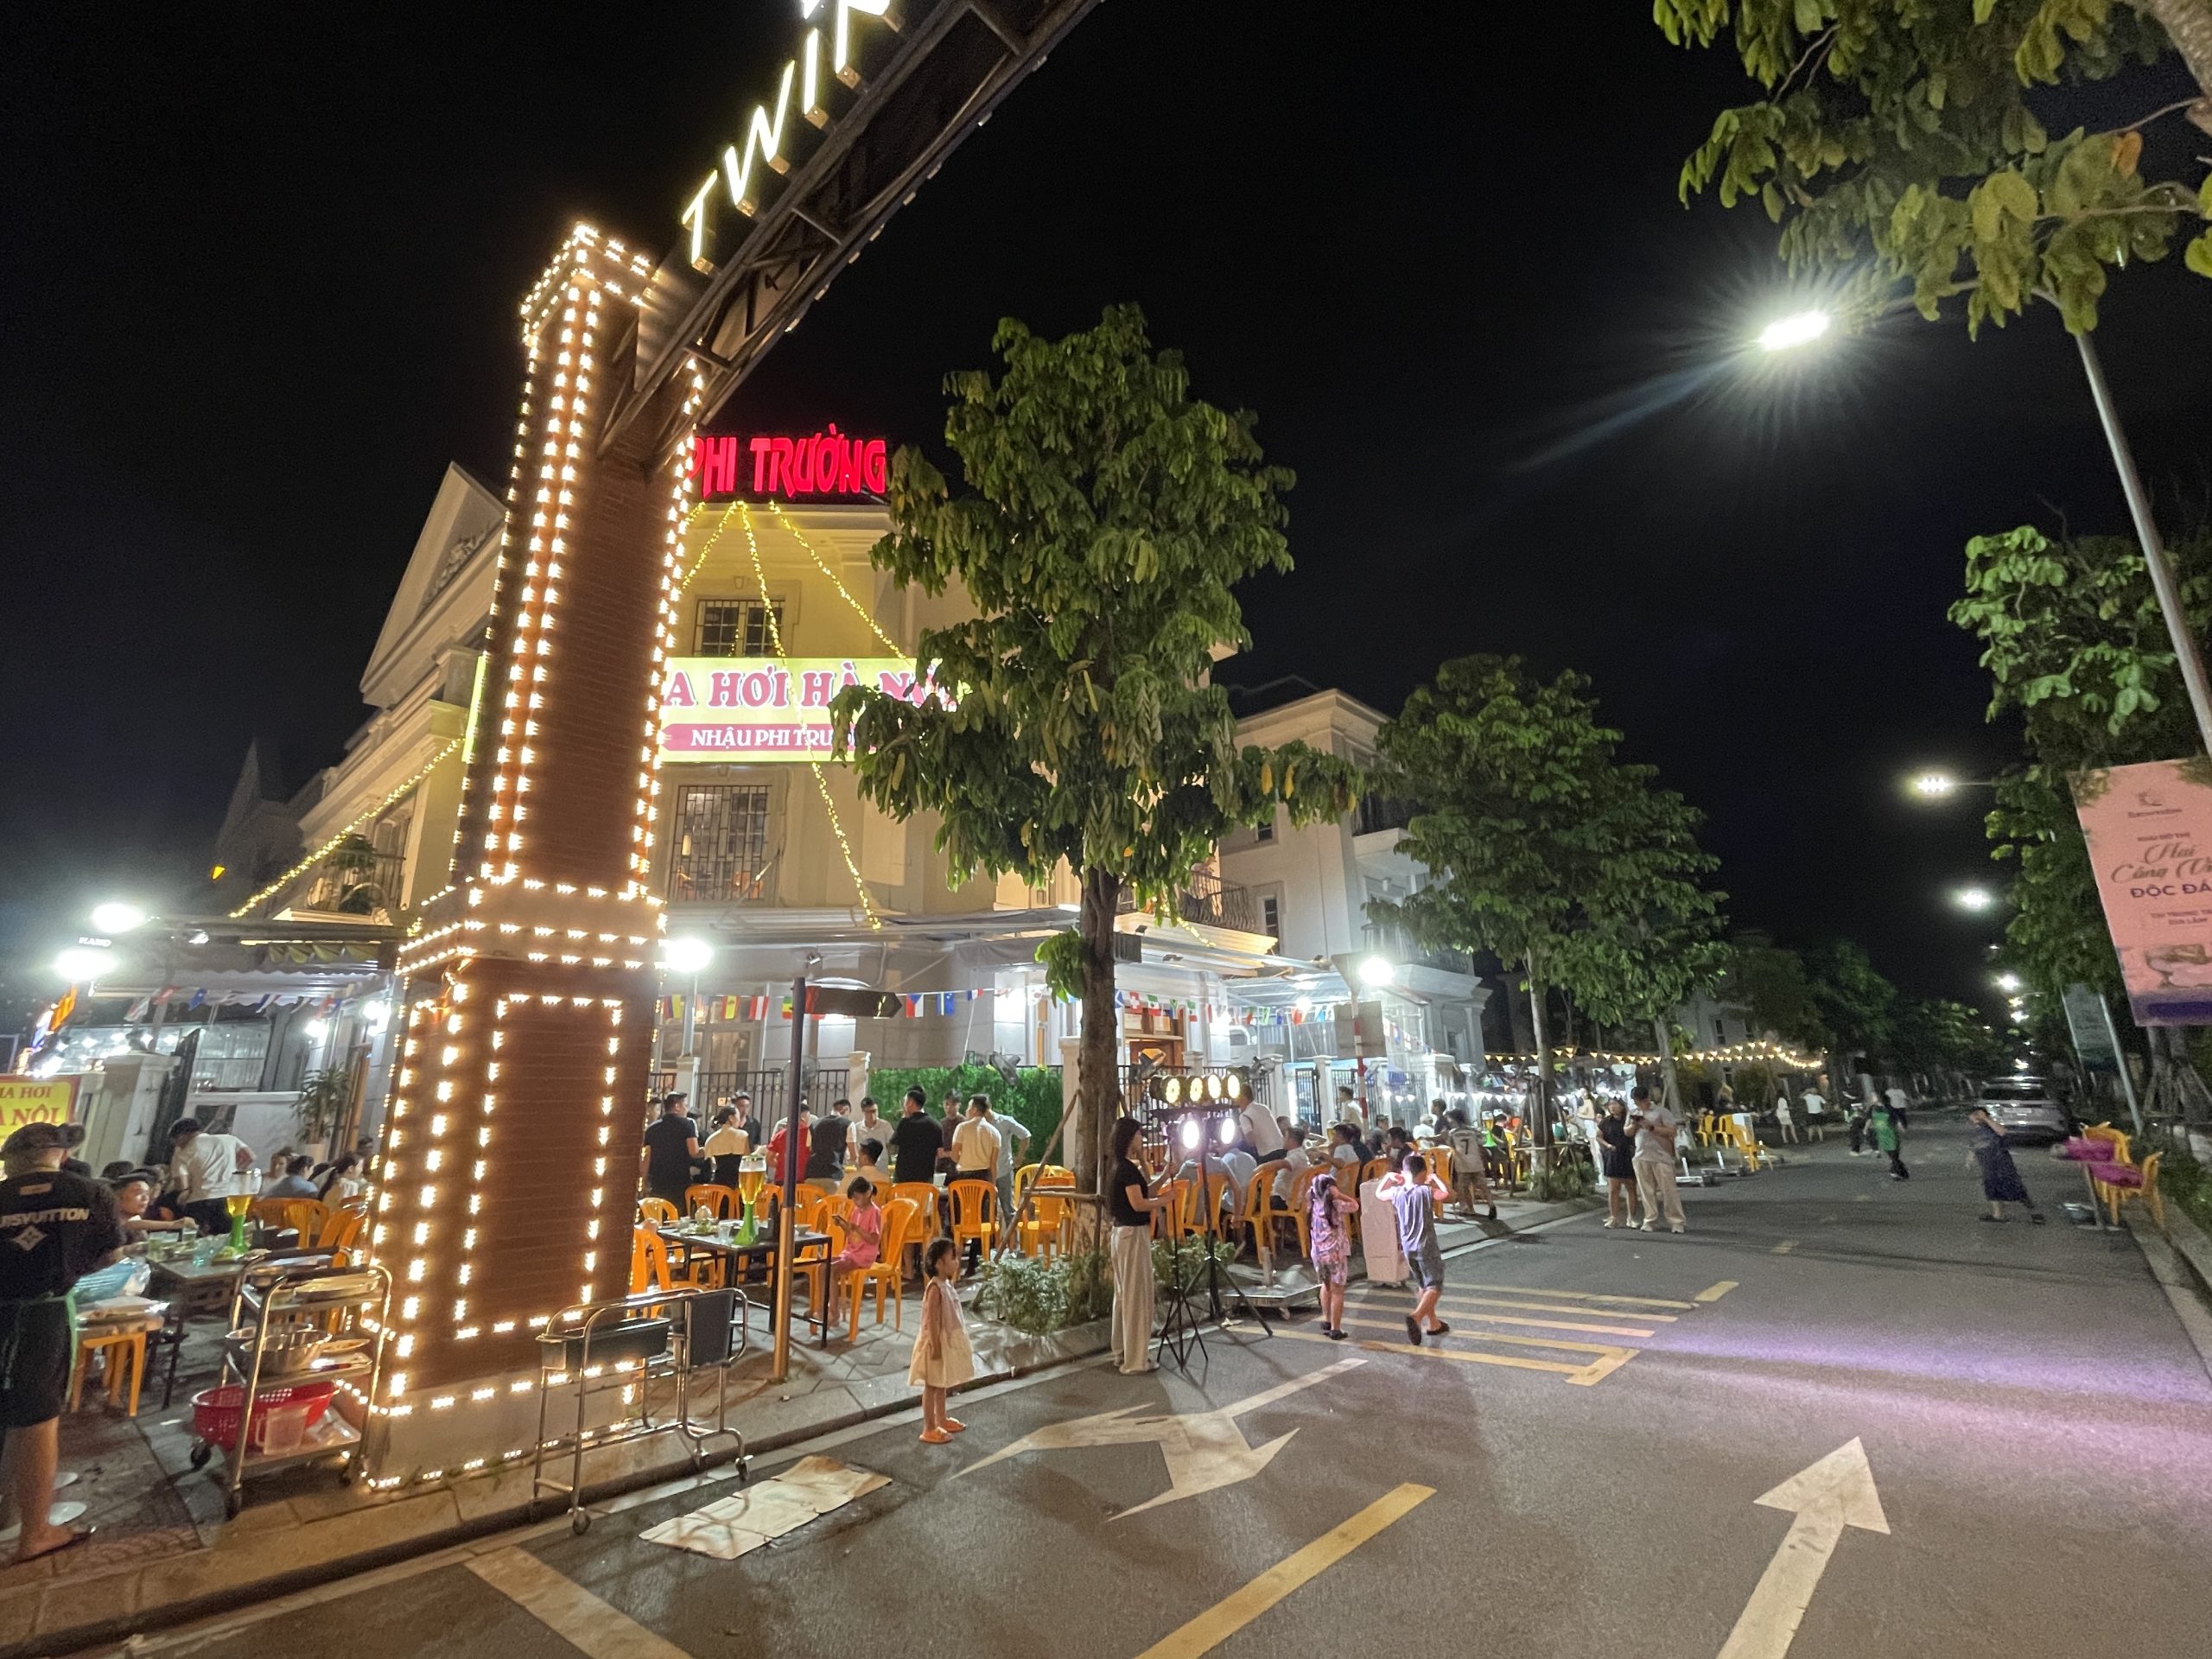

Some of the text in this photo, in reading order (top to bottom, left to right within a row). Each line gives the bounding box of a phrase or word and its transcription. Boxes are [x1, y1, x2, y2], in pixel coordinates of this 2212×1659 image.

[749, 423, 887, 498] TRƯỜNG
[709, 665, 789, 707] HƠI
[691, 727, 751, 750] NHẬU
[754, 729, 791, 747] PHI
[2130, 883, 2177, 899] ĐỘC
